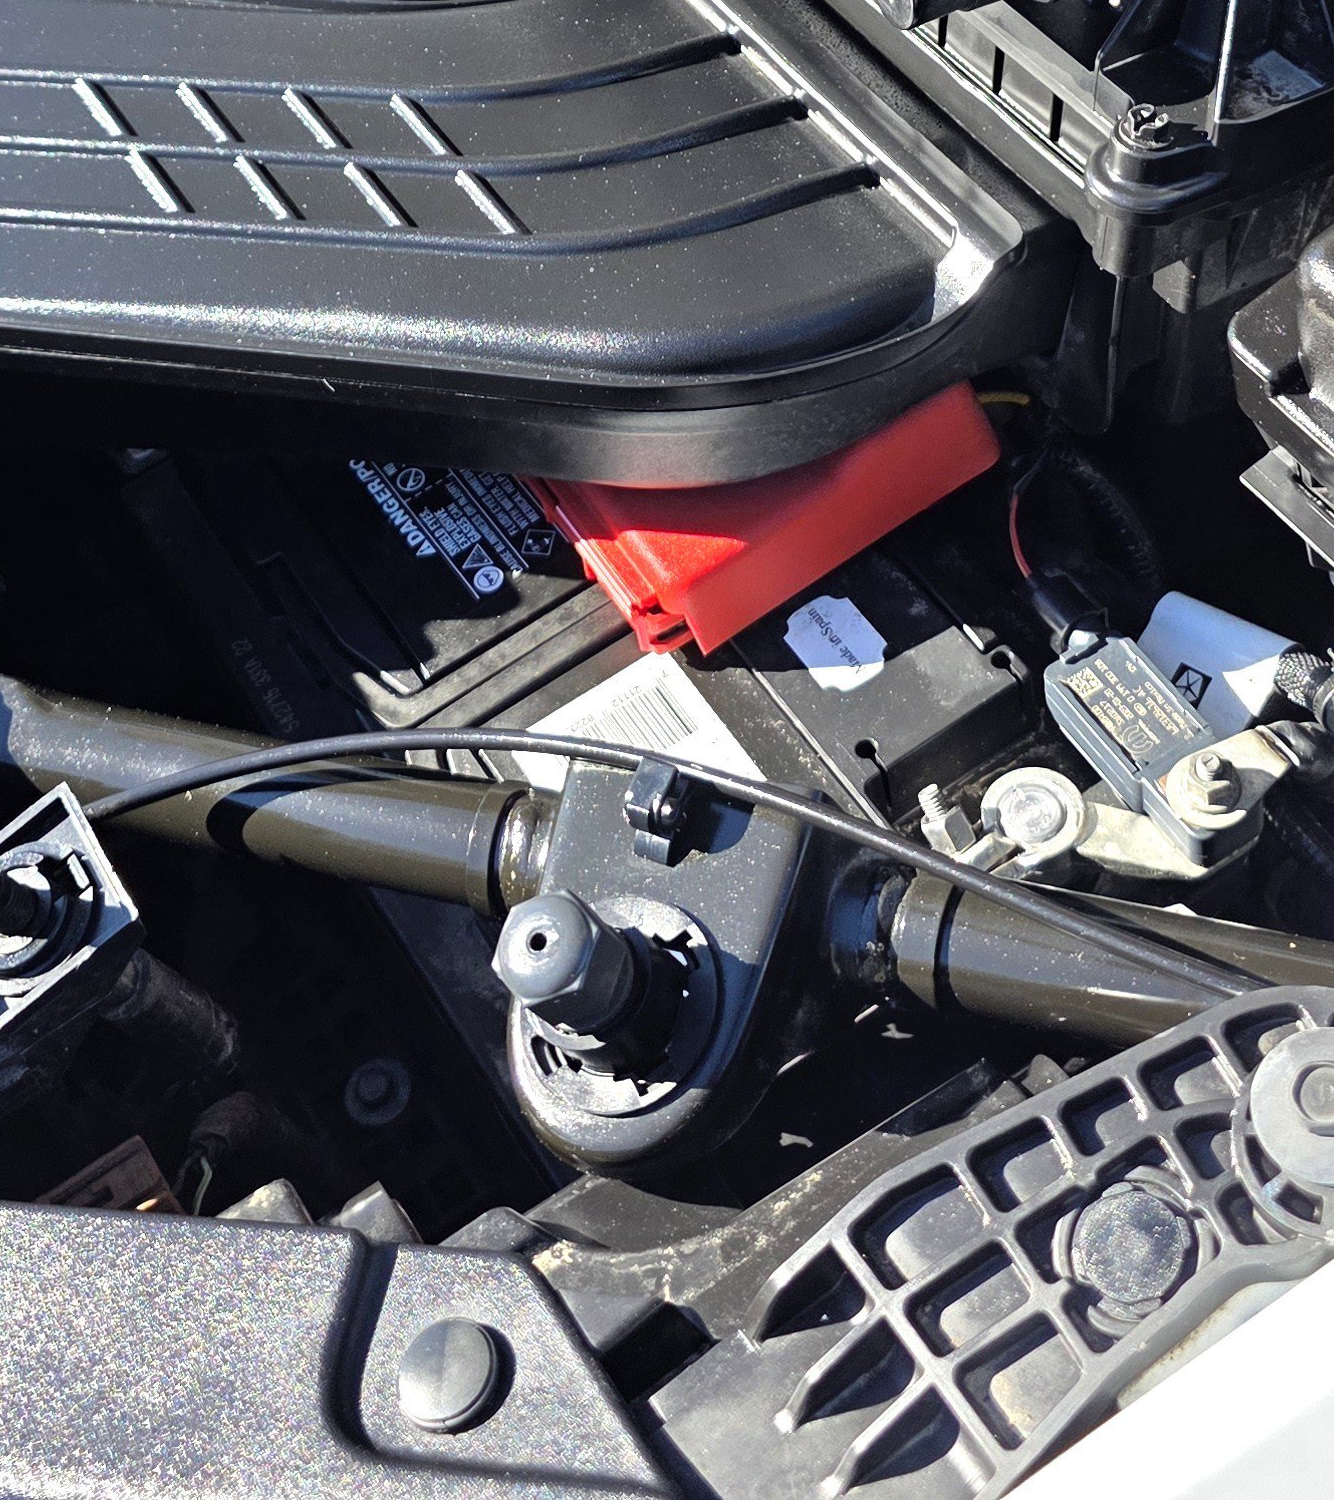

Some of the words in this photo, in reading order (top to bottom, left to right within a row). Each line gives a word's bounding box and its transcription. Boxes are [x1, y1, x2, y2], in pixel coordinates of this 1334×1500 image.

[446, 501, 463, 519] CAN
[480, 492, 501, 514] EYES
[510, 491, 540, 522] MEDICAL
[433, 506, 471, 549] EXPLOSIVE
[455, 515, 482, 543] GASES
[471, 513, 505, 552] BLINDNESS
[495, 510, 519, 535] FLUSH
[508, 507, 529, 530] WITH
[433, 527, 461, 556] SHIELD
[804, 606, 835, 637] Spain
[836, 644, 865, 673] Made
